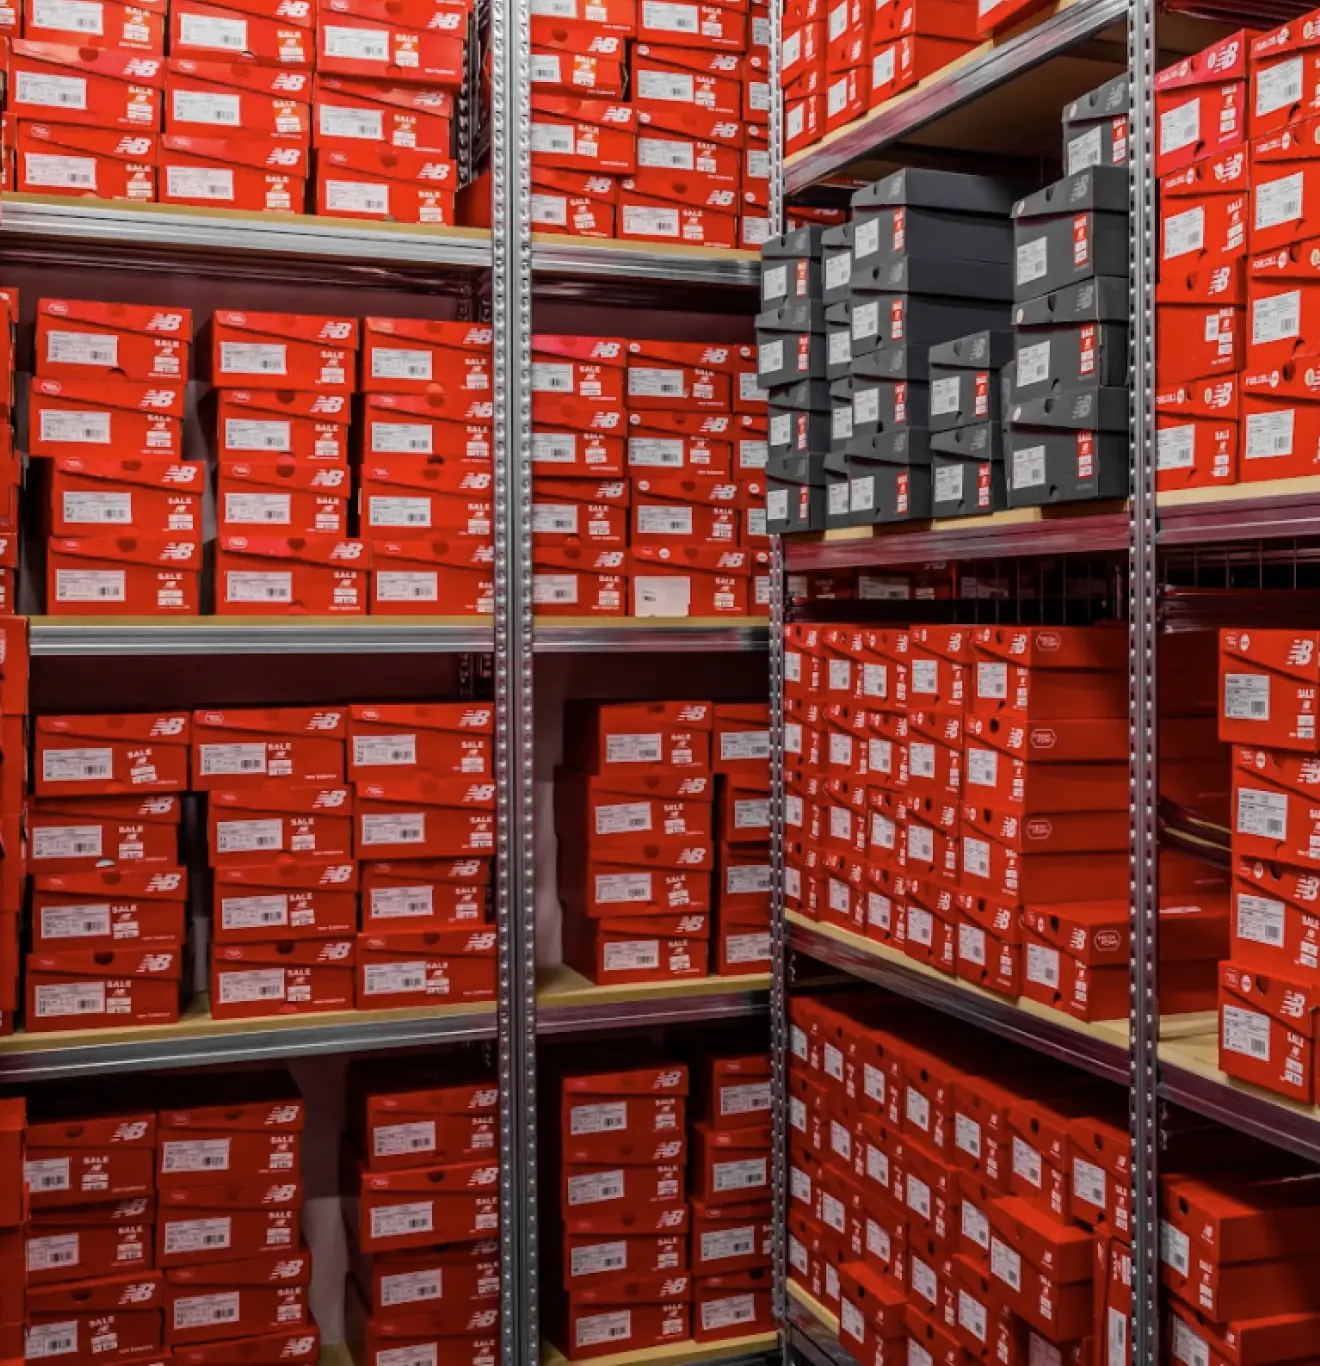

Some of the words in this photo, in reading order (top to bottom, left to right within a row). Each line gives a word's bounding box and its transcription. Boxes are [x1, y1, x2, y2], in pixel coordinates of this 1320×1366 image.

[428, 13, 461, 29] NB
[123, 58, 159, 77] NB
[709, 55, 738, 70] NB
[272, 73, 305, 91] NB
[602, 106, 632, 122] NB
[115, 137, 151, 154] NB
[267, 148, 300, 165] NB
[419, 163, 450, 180] NB
[147, 313, 182, 330] NB
[319, 322, 351, 338] NB
[591, 342, 620, 357] NB
[162, 466, 197, 482] NB
[311, 469, 344, 486] NB
[331, 543, 363, 559] NB
[594, 552, 624, 567] NB
[1287, 640, 1313, 665] NB
[306, 713, 341, 729] NB
[460, 710, 490, 726] NB
[678, 706, 706, 720] NB
[150, 718, 185, 736] NB
[678, 778, 706, 794] NB
[313, 790, 346, 808] NB
[320, 865, 353, 884] NB
[318, 942, 351, 961] NB
[136, 954, 172, 972] NB
